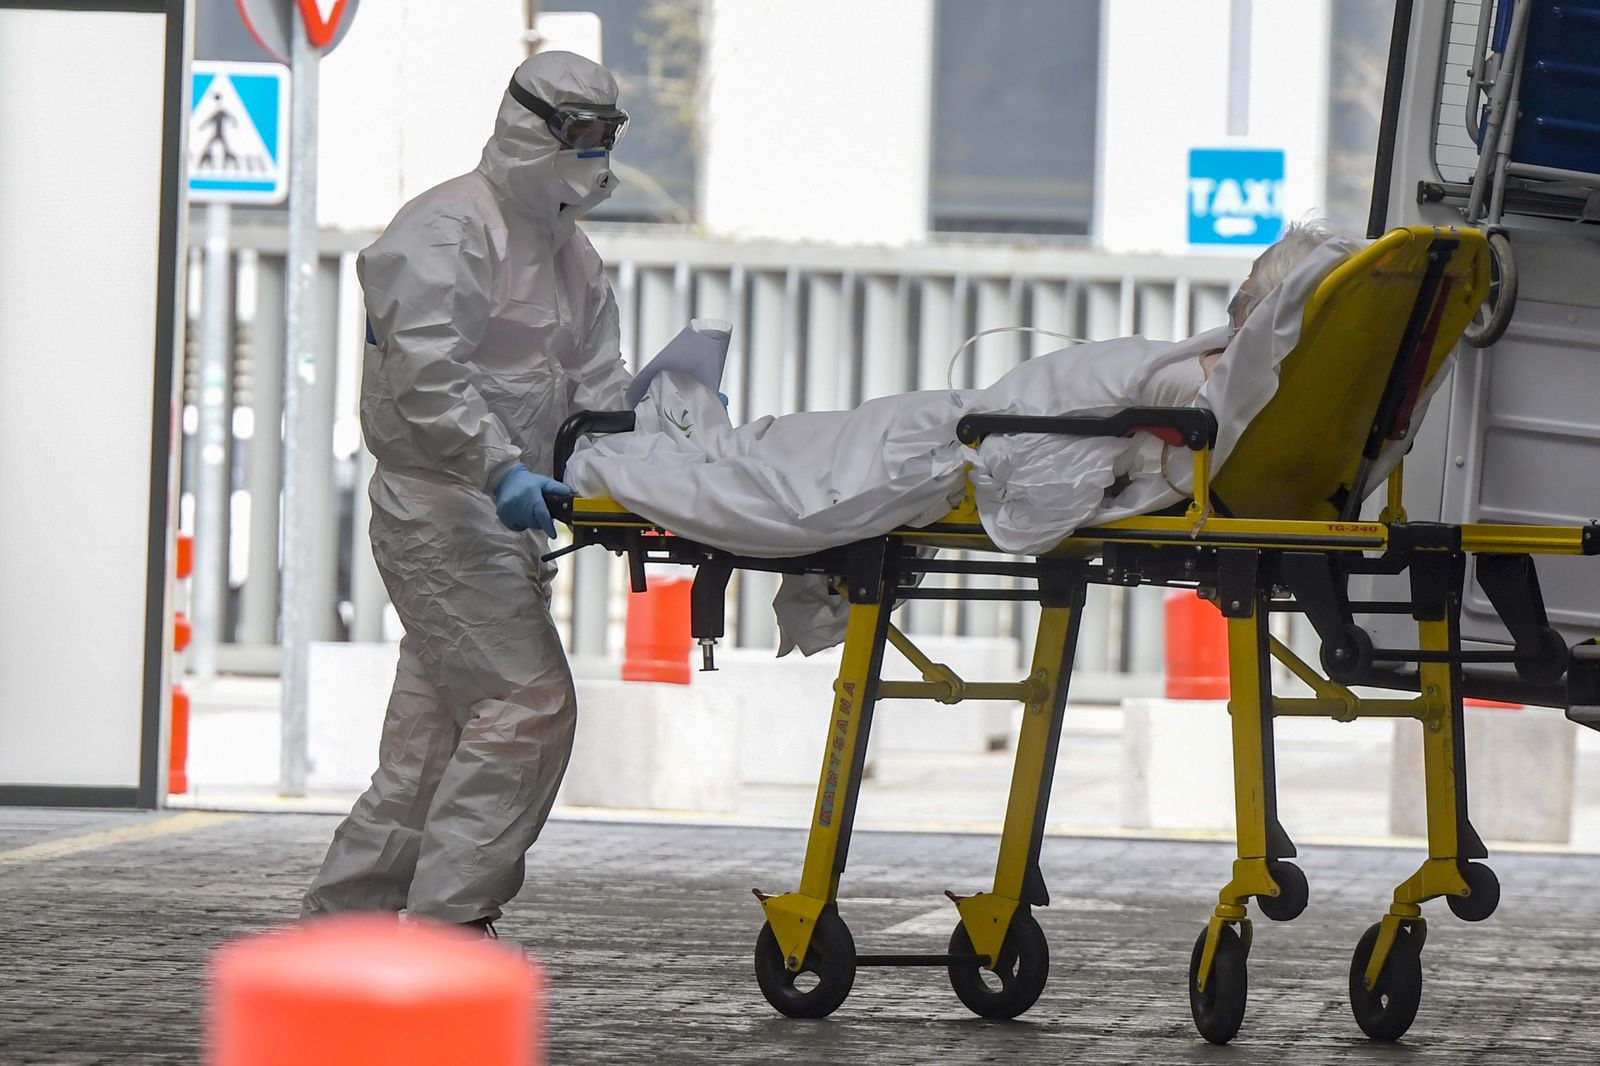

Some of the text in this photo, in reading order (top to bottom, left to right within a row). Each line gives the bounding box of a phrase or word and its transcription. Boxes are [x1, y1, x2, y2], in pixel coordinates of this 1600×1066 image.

[1189, 178, 1284, 217] TAXI
[1327, 524, 1378, 533] TG-240
[819, 682, 856, 826] KARTSANA
